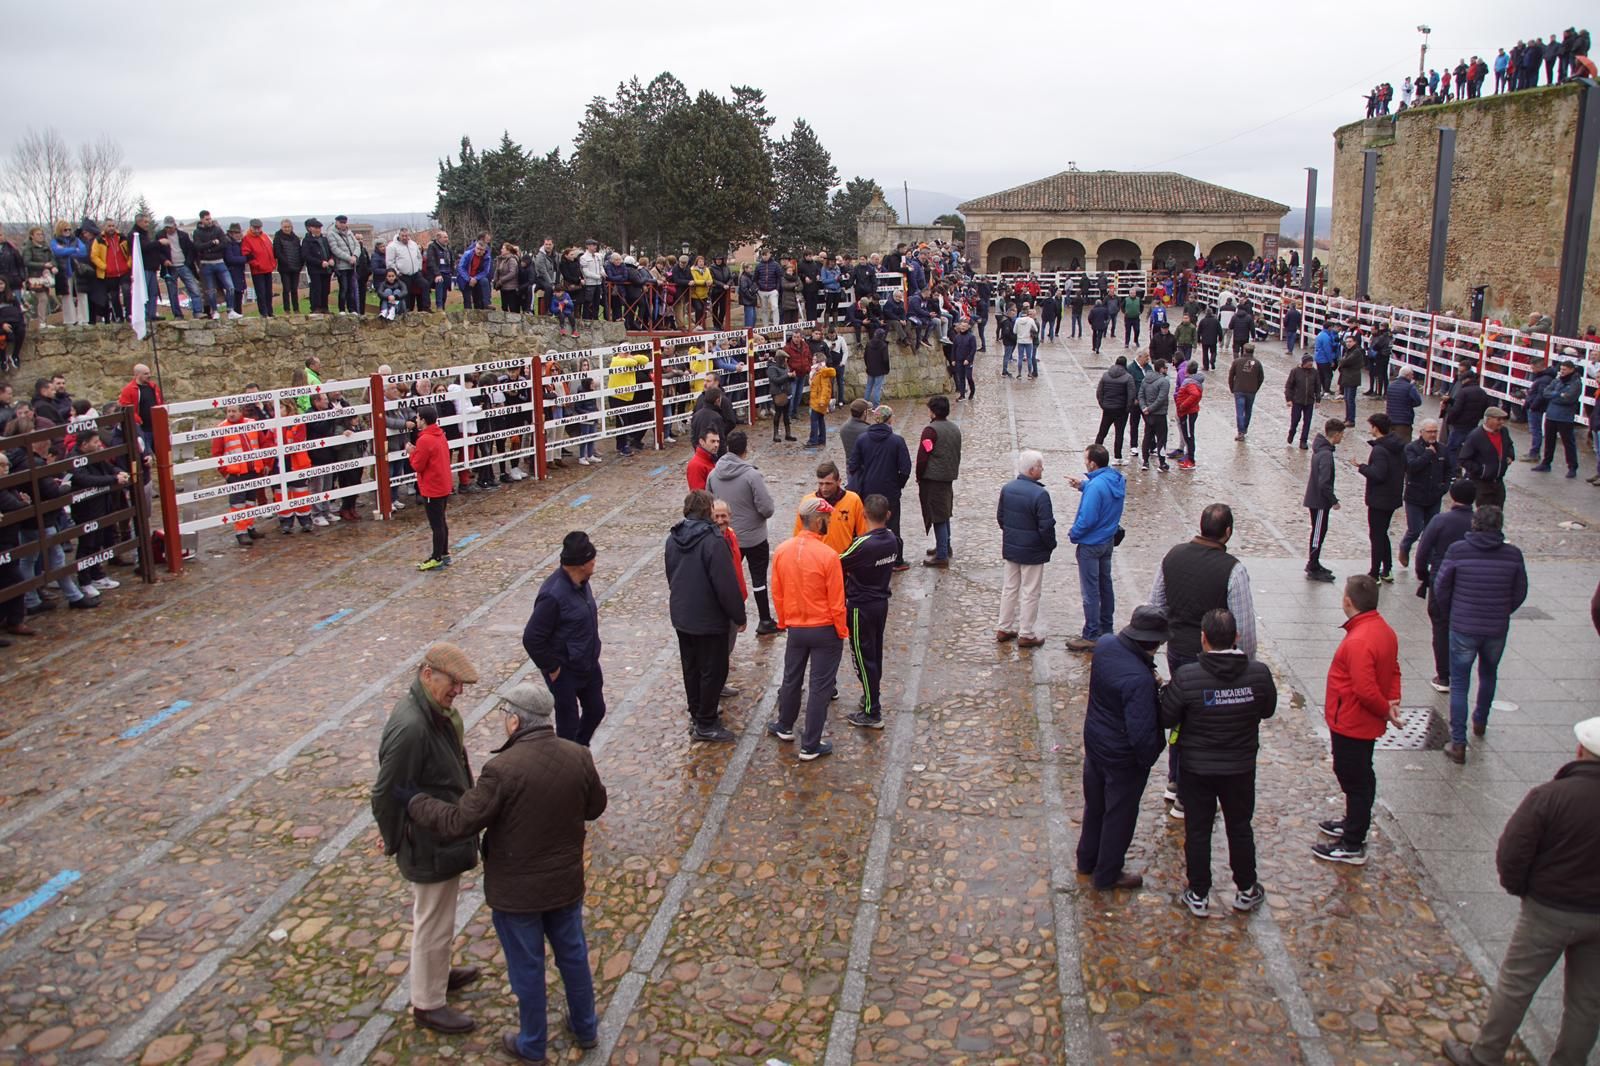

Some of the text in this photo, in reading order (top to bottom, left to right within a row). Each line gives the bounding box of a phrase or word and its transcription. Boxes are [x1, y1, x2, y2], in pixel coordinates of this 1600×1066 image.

[665, 336, 702, 346] GENERALI
[713, 331, 744, 339] SEGUROS
[612, 343, 651, 353] SEGUROS
[545, 350, 592, 361] GENERALI
[475, 359, 526, 372] SEGUROS
[388, 369, 450, 383] GENERALI
[222, 387, 312, 406] USO EXCLUSIVO CRUZ ROJA
[485, 410, 497, 418] 923
[186, 430, 210, 441] Excmo.
[210, 422, 266, 437] AYUNTAMIENTO
[301, 412, 327, 423] CIUDAD
[327, 407, 356, 419] RODRIGO
[474, 426, 531, 443] CIUDAD RODRIGO
[227, 441, 317, 464] USO EXCLUSIVO CRUZ ROJA
[73, 456, 89, 468] CID
[193, 460, 360, 500] Excmo. AYUNTAMIENTO de CIUDAD RODRIGO
[231, 495, 321, 522] USO EXCLUSIVO CRUZ ROJA
[83, 520, 99, 533] CID
[77, 549, 115, 571] REGALOS
